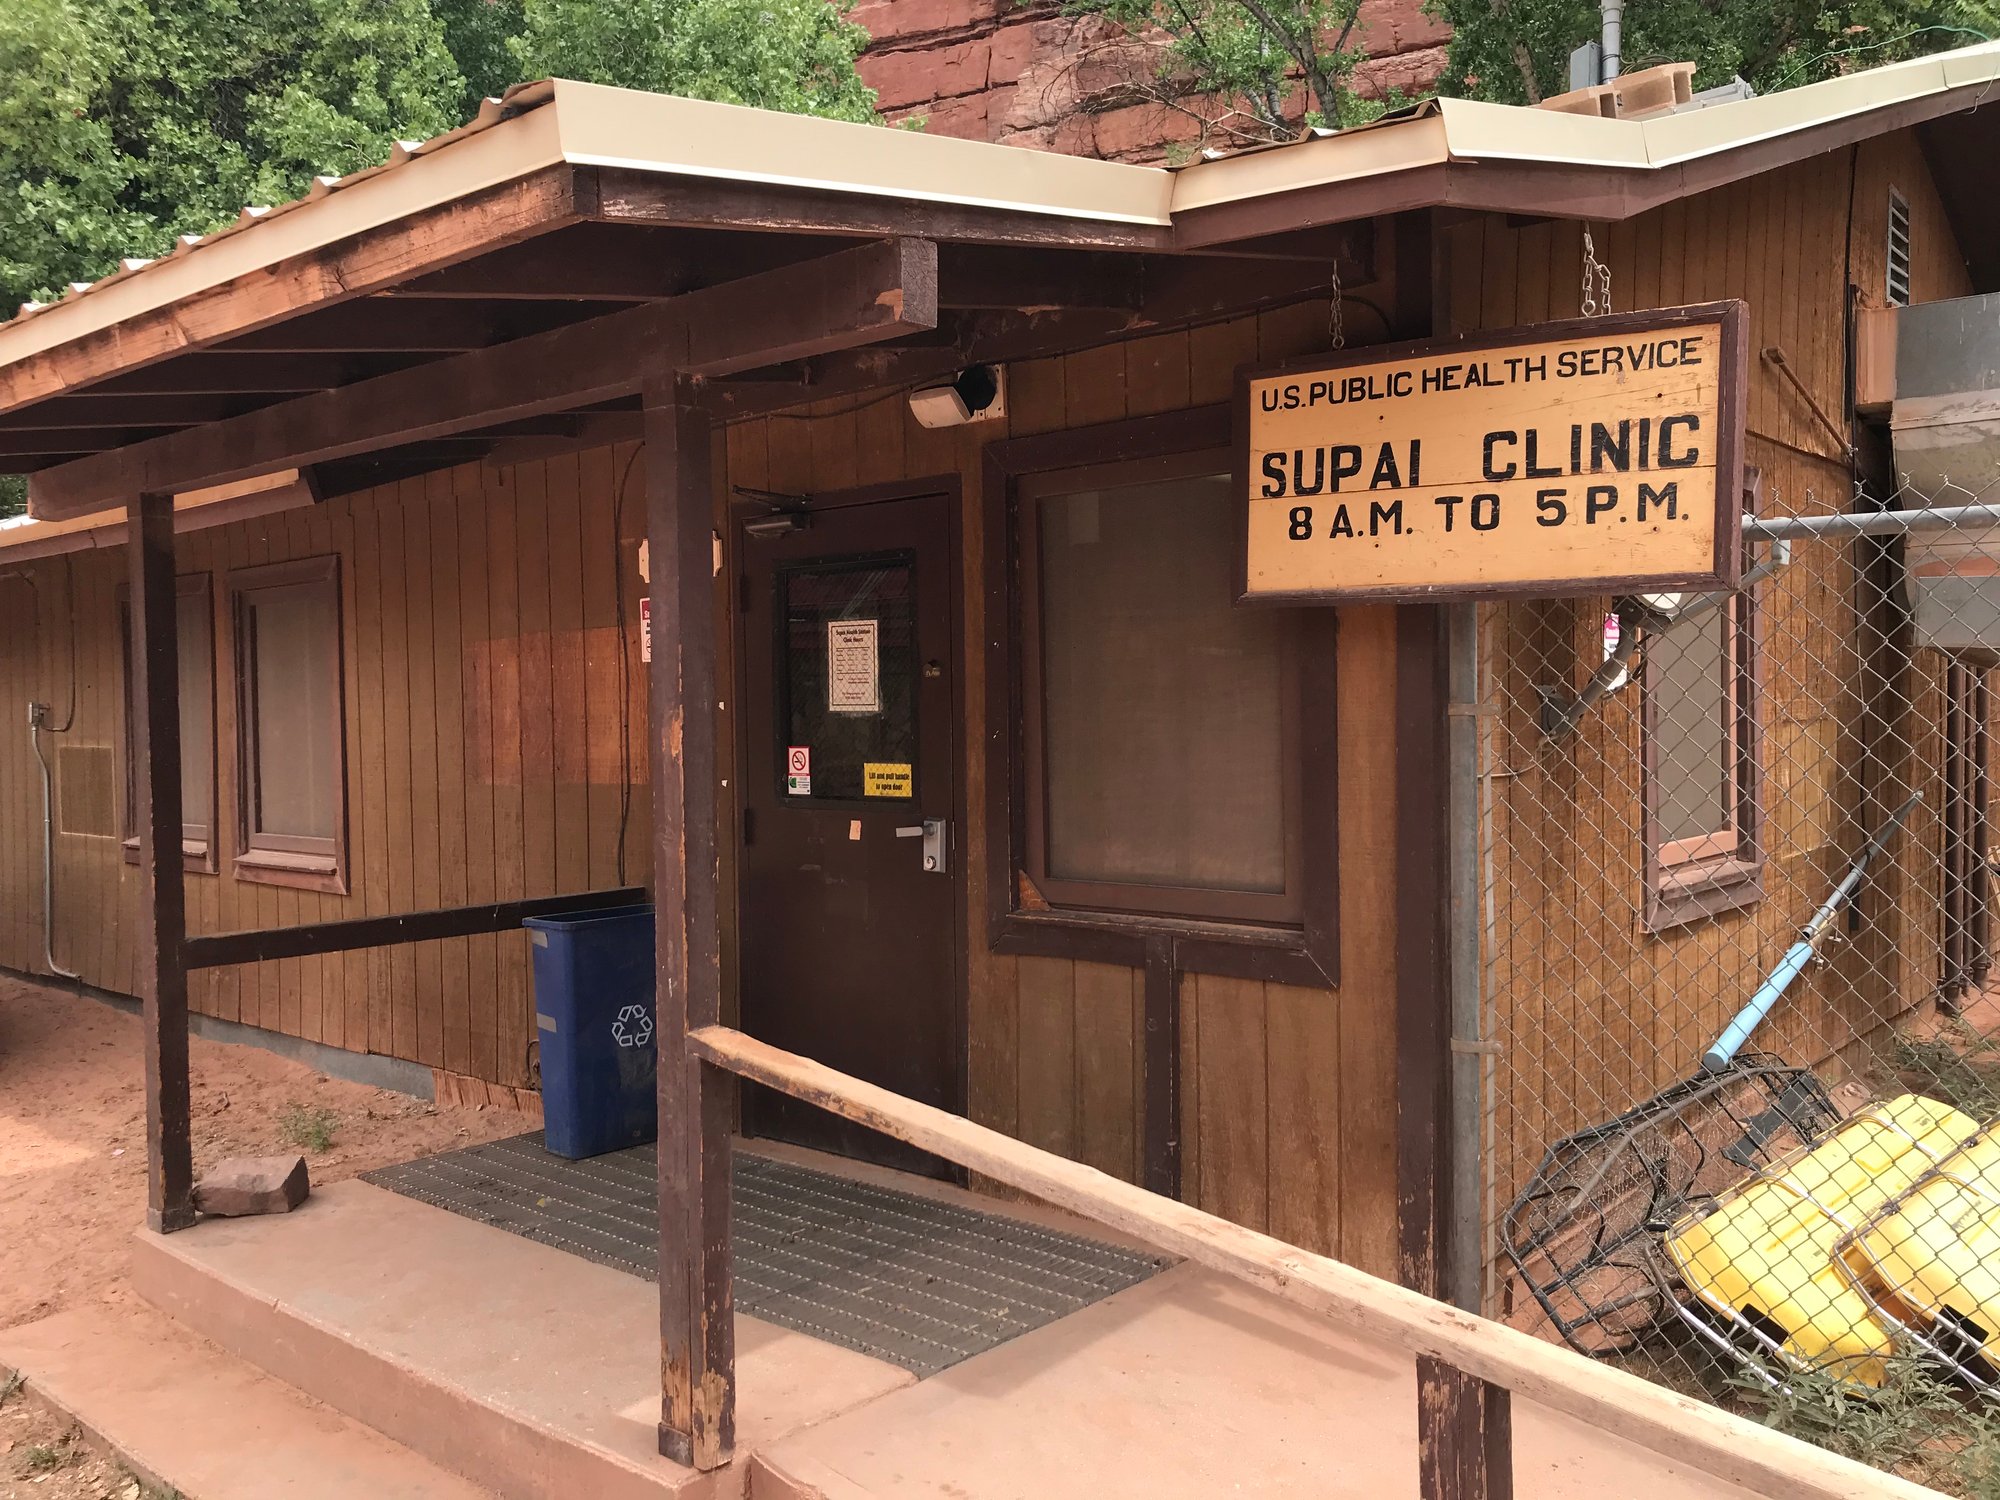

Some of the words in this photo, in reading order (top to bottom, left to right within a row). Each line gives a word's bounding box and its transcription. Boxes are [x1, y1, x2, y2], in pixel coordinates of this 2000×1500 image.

[1422, 355, 1547, 393] HEALTH
[1556, 336, 1703, 377] SERVICE
[1261, 439, 1421, 498] SUPAI
[1482, 414, 1700, 482] CLINIC
[1288, 506, 1313, 541] 8
[1329, 500, 1413, 539] A.M.
[1434, 493, 1501, 533] TO
[1536, 488, 1567, 527] 5
[1585, 481, 1690, 525] P.M.
